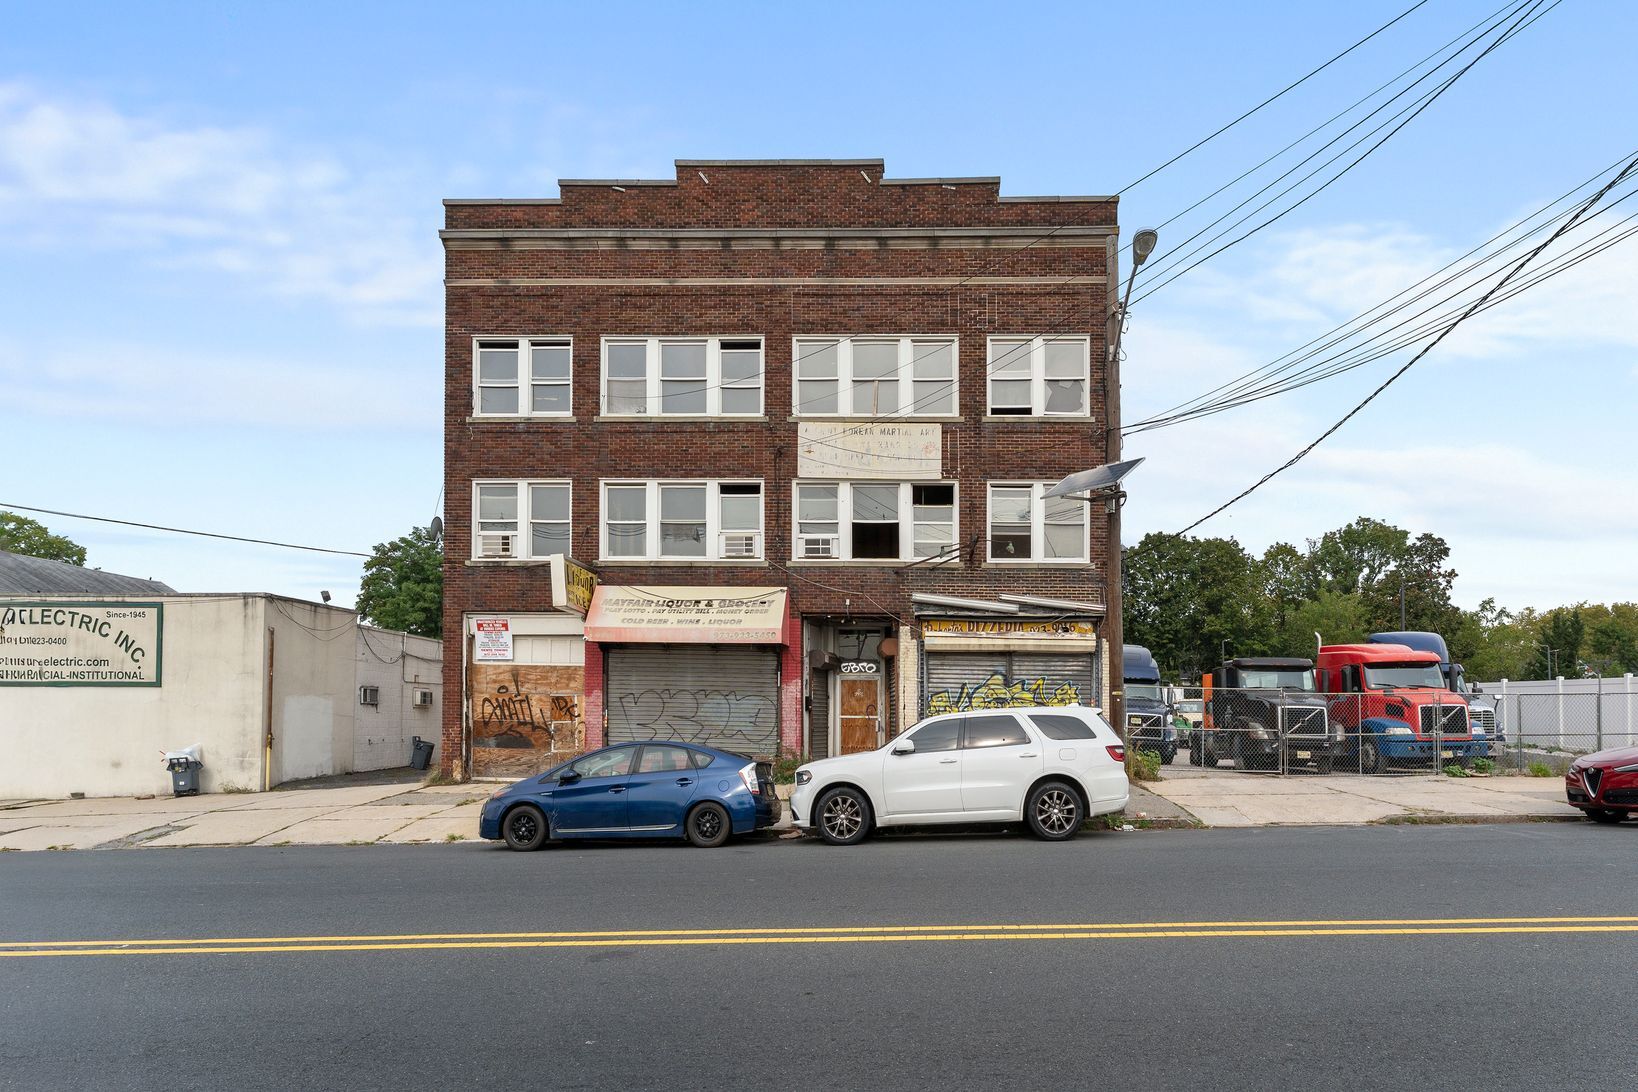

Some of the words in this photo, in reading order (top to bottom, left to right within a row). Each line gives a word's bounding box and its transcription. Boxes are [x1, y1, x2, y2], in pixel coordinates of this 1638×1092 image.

[601, 599, 652, 608] MAYFAIR
[655, 599, 701, 609] LIQUOR
[705, 600, 714, 608] &
[718, 600, 776, 609] GROCERY
[106, 611, 146, 619] Since-1945
[114, 630, 145, 669] INC.
